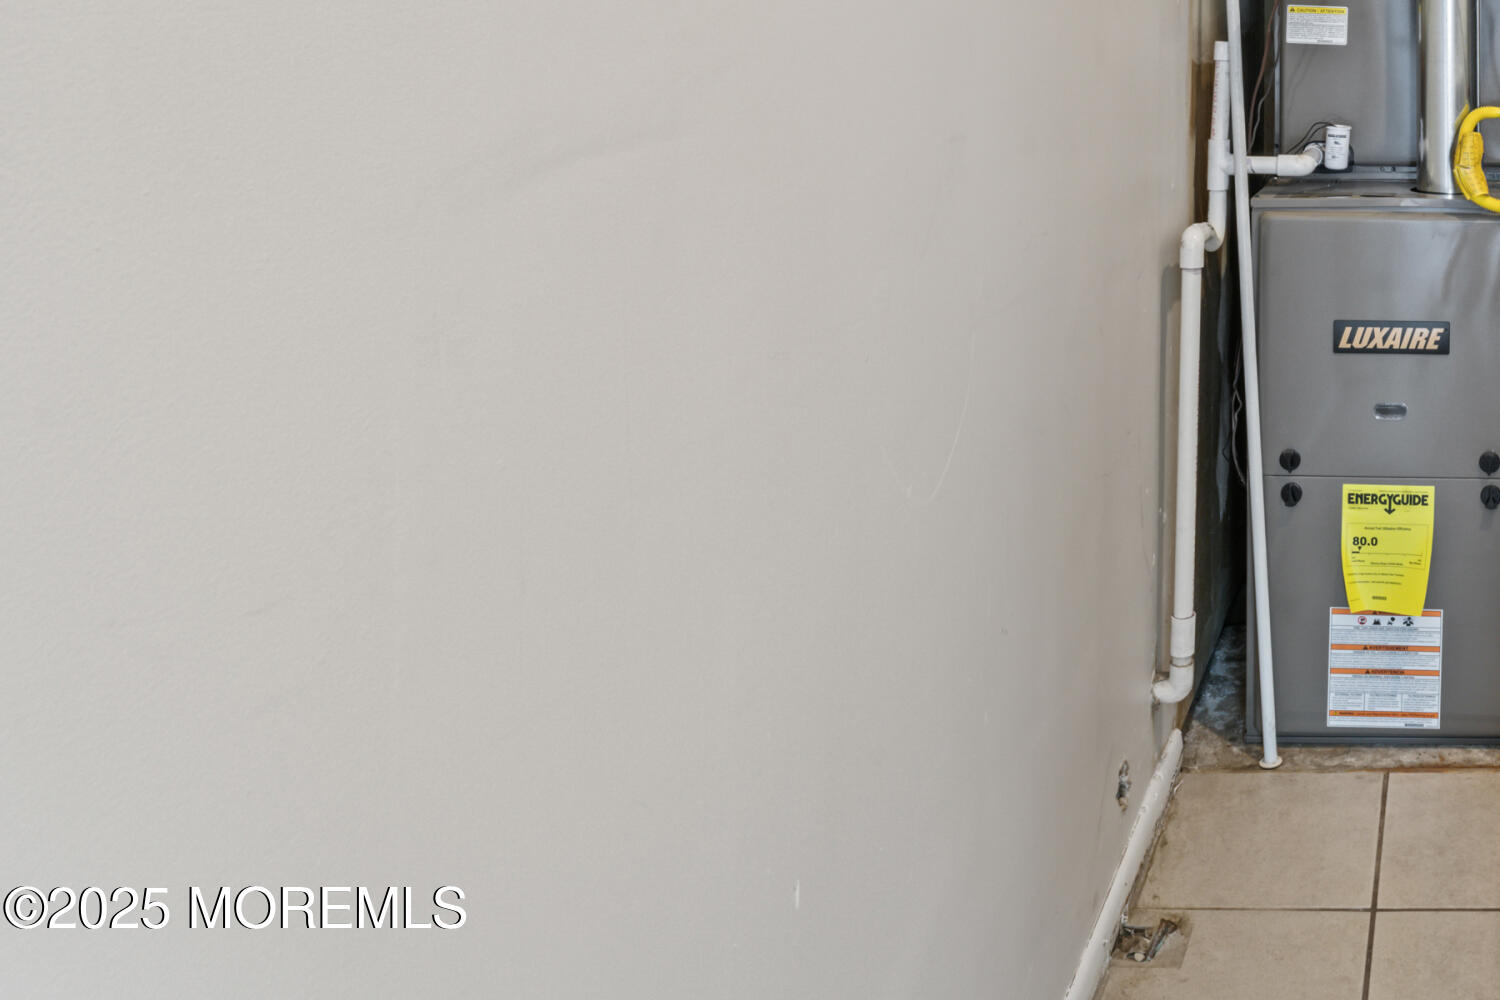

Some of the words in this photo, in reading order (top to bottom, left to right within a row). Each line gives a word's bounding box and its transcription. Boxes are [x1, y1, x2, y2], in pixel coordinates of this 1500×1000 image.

[1338, 326, 1445, 350] LUXAIRE
[1347, 492, 1429, 508] ENERGYGUIDE
[1352, 536, 1378, 547] 80.0
